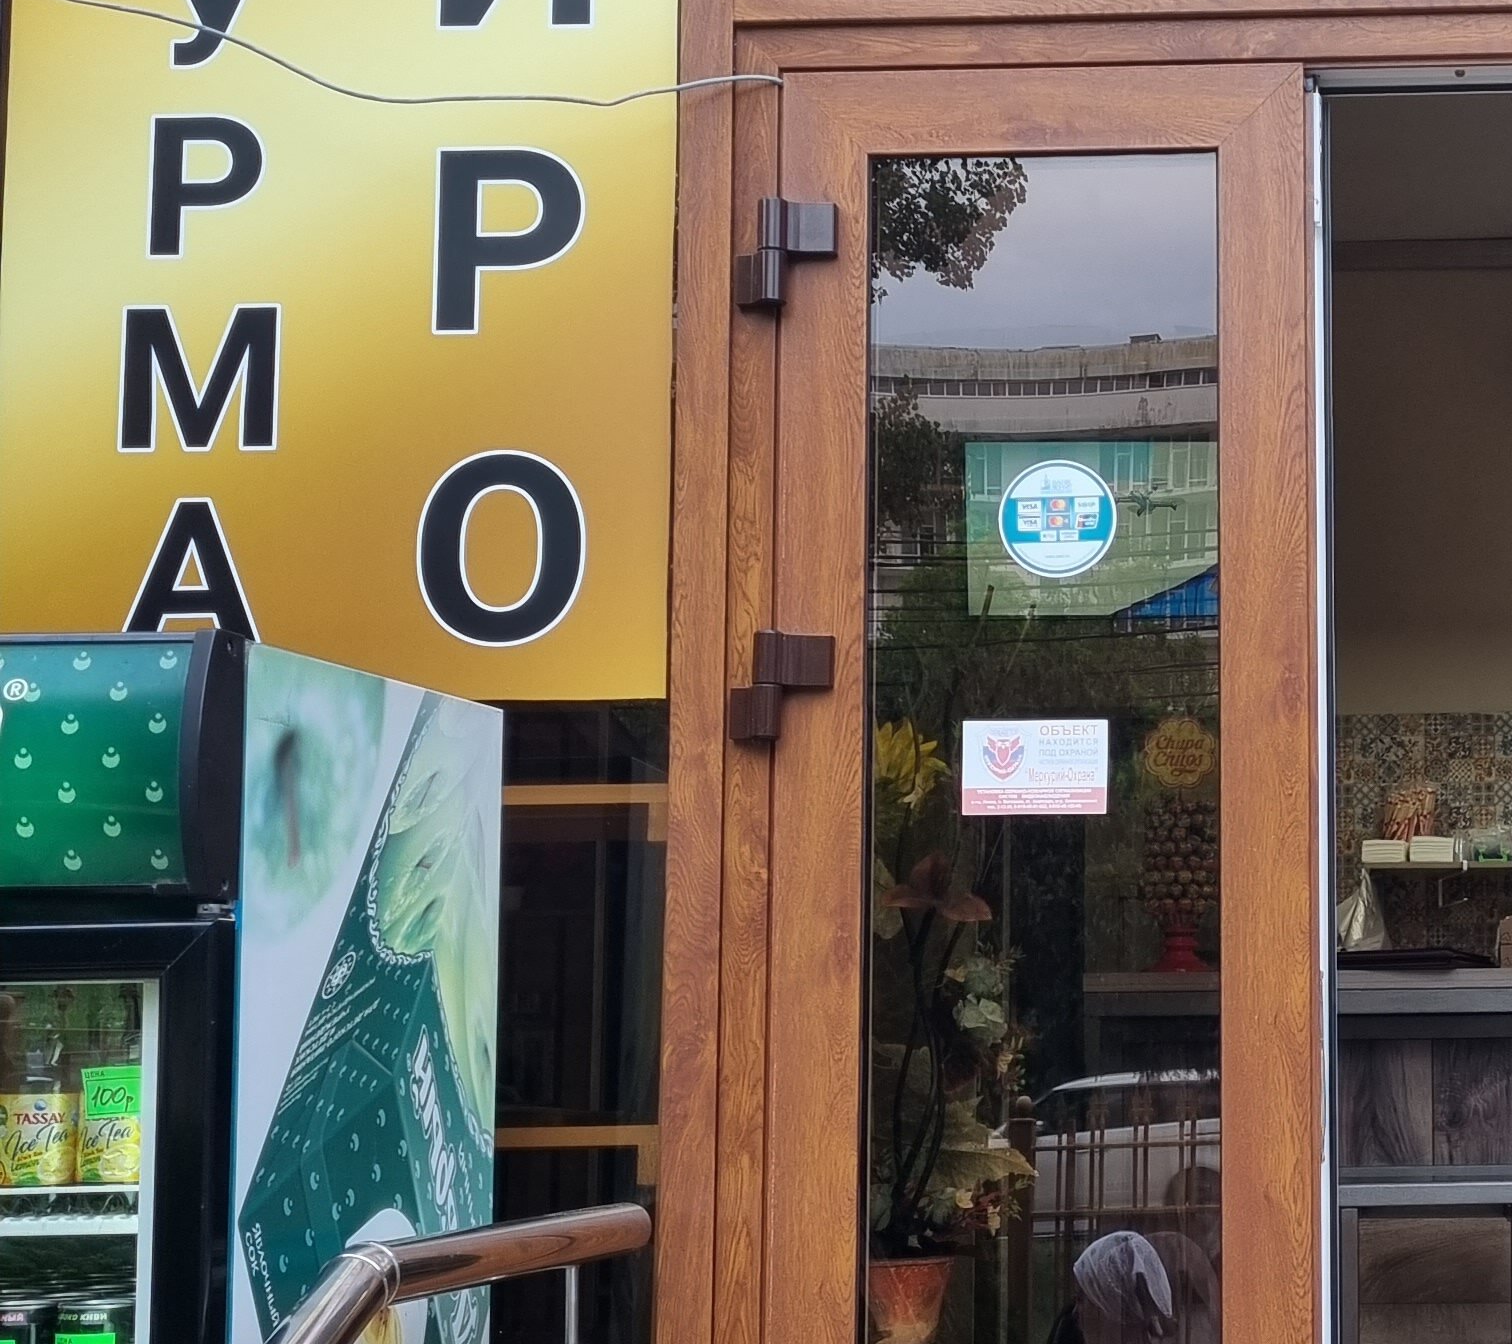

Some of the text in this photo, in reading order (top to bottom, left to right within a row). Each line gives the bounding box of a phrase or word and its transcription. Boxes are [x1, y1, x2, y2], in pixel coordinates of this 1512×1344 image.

[1039, 725, 1098, 736] ОБЪЕКТ
[1039, 737, 1098, 746] НАХОДИТСЯ
[91, 1086, 134, 1112] 100р
[14, 1112, 66, 1125] TASSAY
[245, 1231, 260, 1277] СОК
[252, 1222, 281, 1328] ЯБЛОЧНЫЙ
